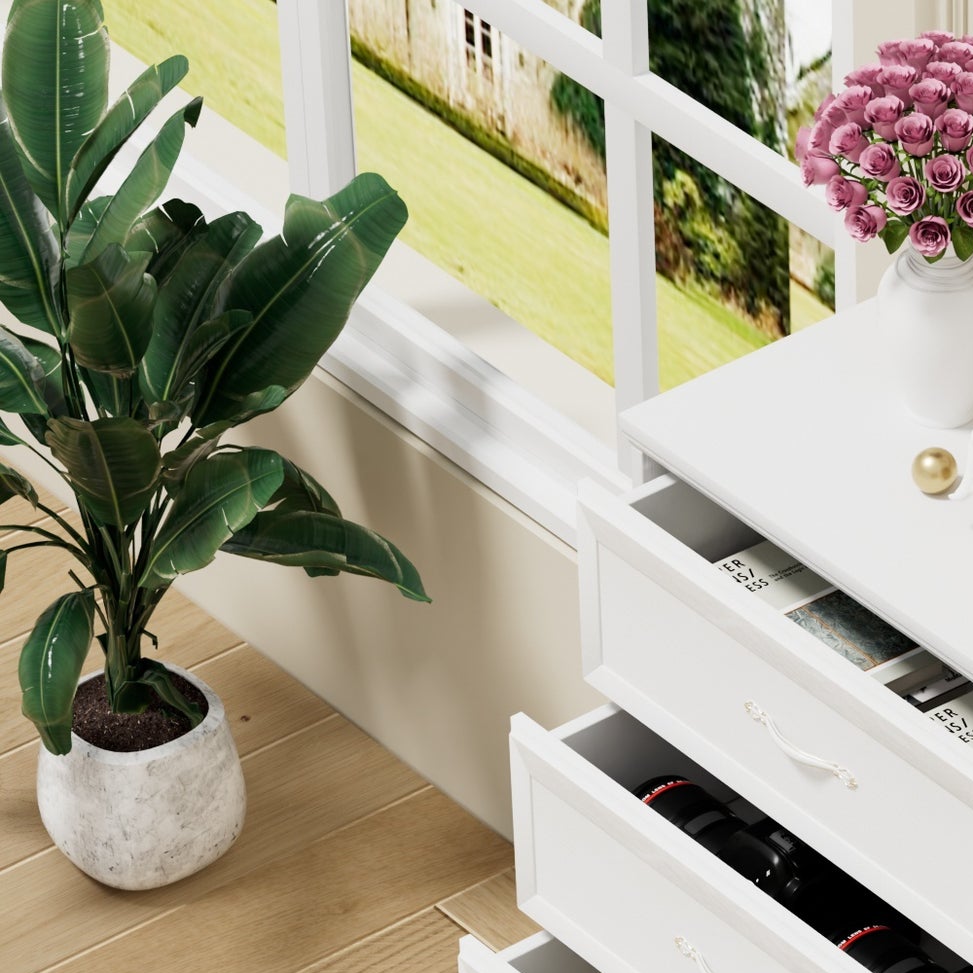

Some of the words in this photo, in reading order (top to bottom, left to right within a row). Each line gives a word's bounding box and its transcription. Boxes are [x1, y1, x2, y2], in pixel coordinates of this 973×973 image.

[718, 559, 746, 572] ER
[745, 578, 769, 593] ESS
[929, 708, 958, 722] ER
